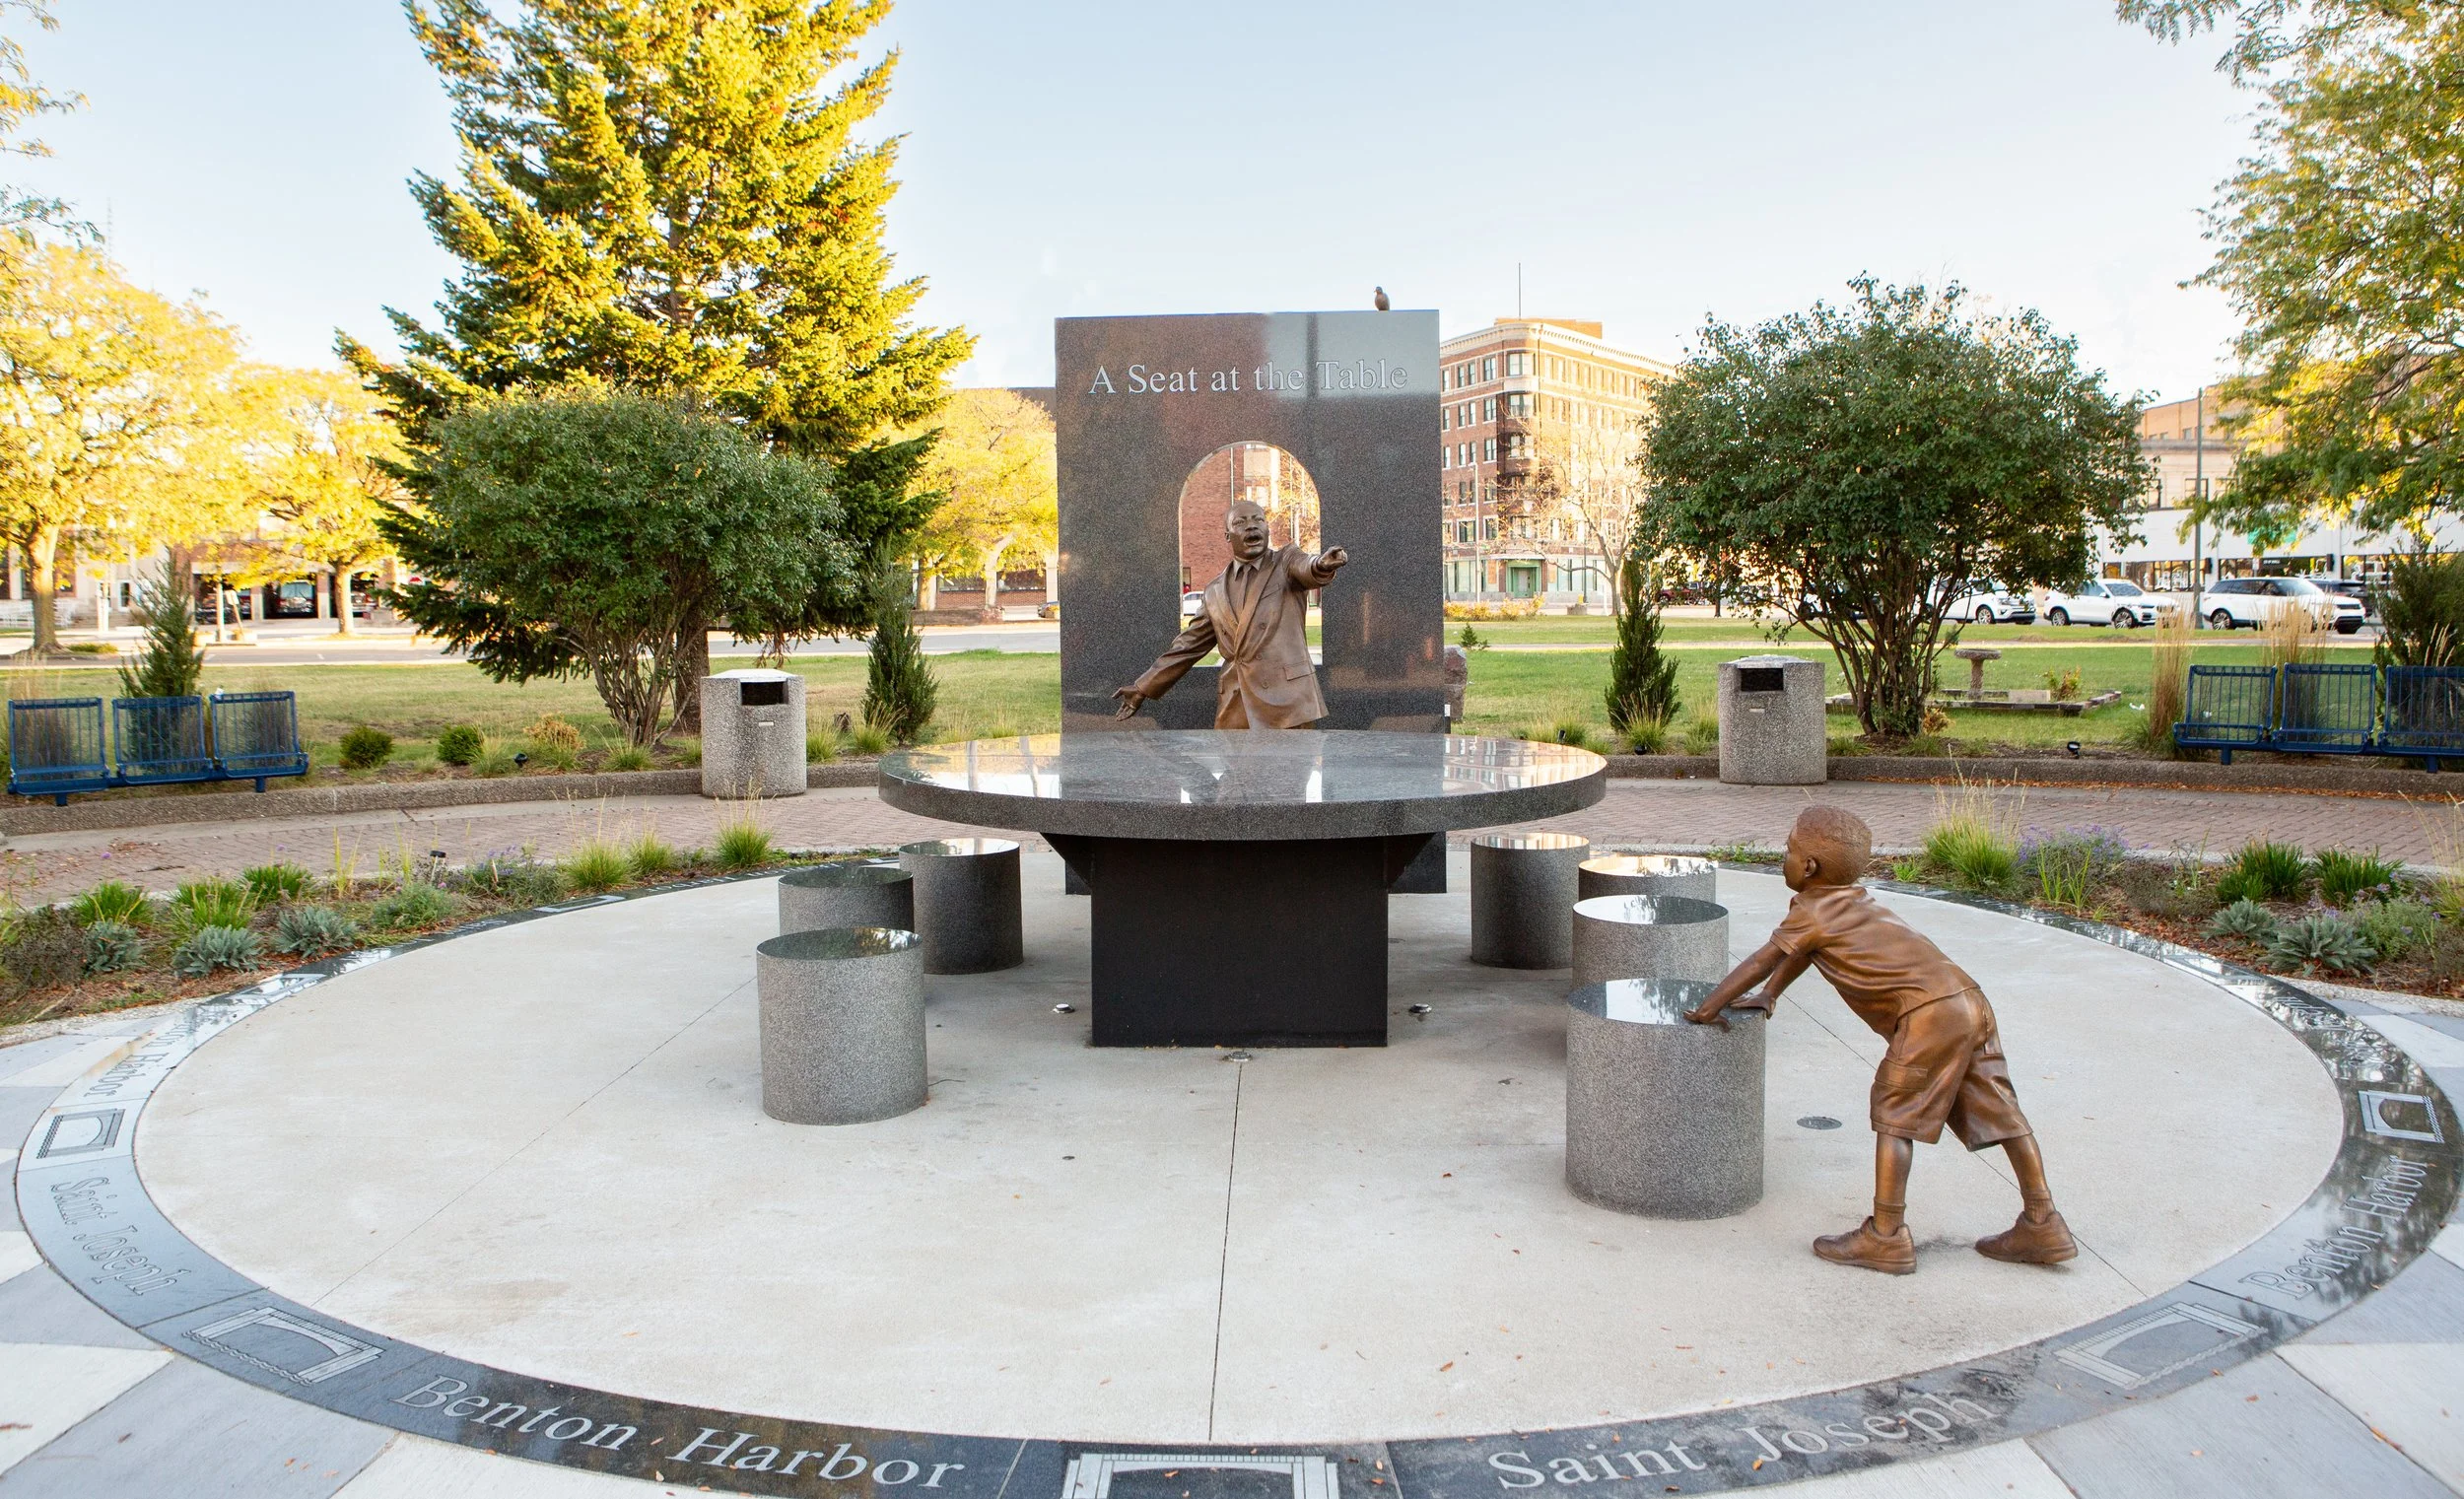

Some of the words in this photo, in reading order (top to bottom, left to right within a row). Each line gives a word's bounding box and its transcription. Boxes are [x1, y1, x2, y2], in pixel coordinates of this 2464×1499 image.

[1088, 366, 1116, 394] A
[1129, 364, 1198, 393] Seat
[1211, 366, 1242, 392] at
[1254, 361, 1305, 391] the
[1316, 360, 1408, 390] Table
[84, 1052, 170, 1098] Harbor
[50, 1176, 118, 1226] Saint
[2237, 1225, 2388, 1301] Benton
[2338, 1154, 2430, 1223] Harbor
[73, 1224, 192, 1297] Joseph
[392, 1374, 642, 1452] Benton
[665, 1426, 966, 1489] Harbor
[1487, 1439, 1708, 1491] Saint
[1735, 1391, 2003, 1464] Joseph
